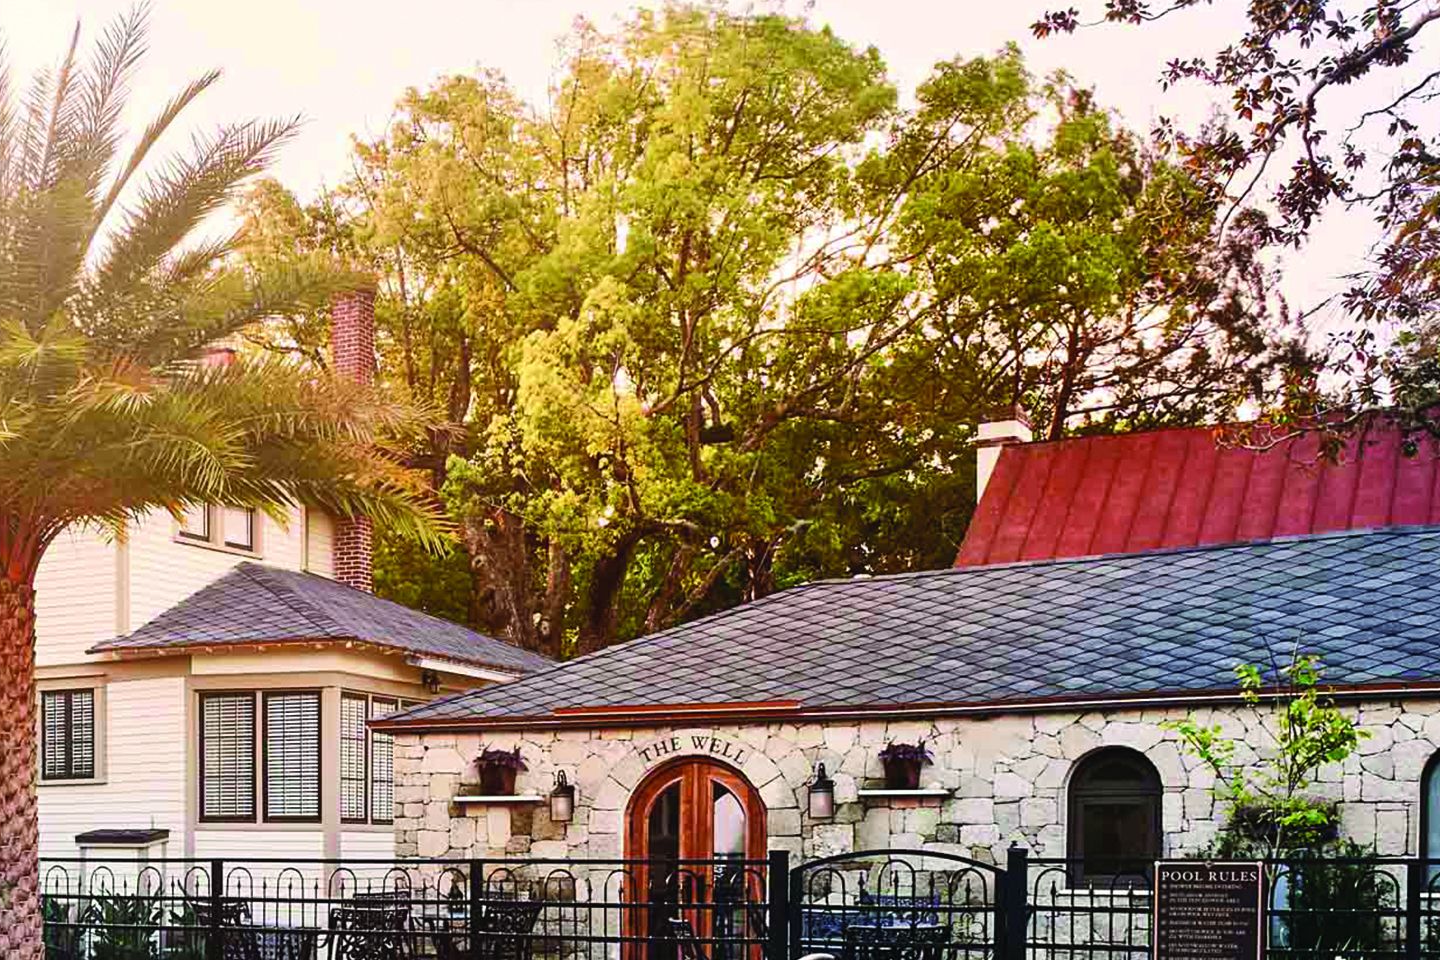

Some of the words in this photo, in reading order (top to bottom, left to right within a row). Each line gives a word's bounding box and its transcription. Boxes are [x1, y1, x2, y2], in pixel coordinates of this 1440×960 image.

[638, 736, 682, 762] THE
[691, 735, 744, 765] WELL
[1162, 871, 1203, 881] POOL
[1209, 871, 1257, 882] RULES
